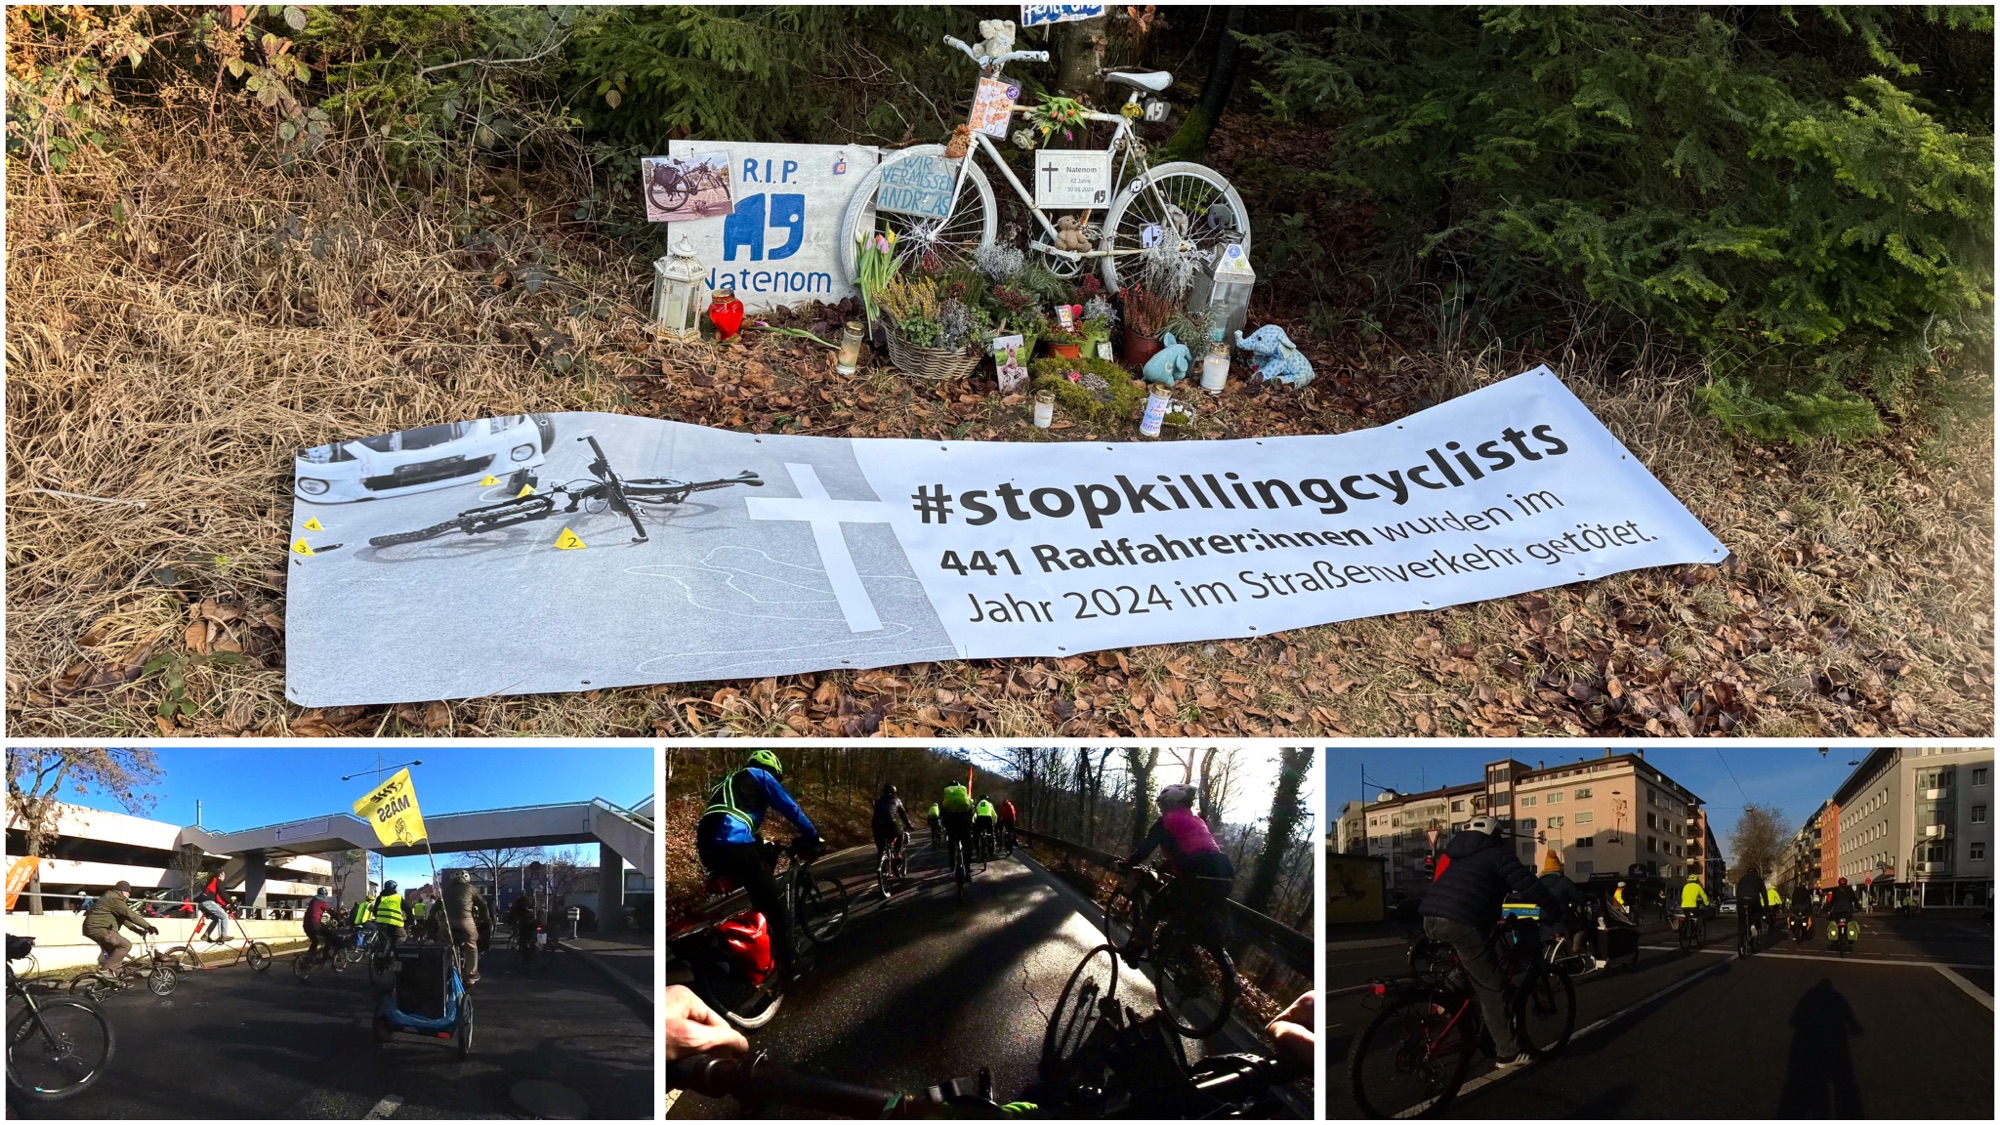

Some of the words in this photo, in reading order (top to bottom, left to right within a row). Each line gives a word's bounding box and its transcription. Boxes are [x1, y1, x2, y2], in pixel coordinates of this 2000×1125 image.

[743, 157, 798, 184] R.I.P.
[904, 156, 933, 171] WIR
[882, 166, 953, 192] VERMISSEN
[878, 186, 952, 217] ANDREAS
[911, 424, 1569, 529] #stopkillingcyclists
[567, 537, 578, 548] 2
[940, 550, 1022, 576] 441
[1030, 528, 1374, 573] Radfahrer:innen
[1372, 510, 1514, 543] wurden
[1506, 490, 1565, 516] im
[967, 593, 1054, 623] Jahr
[1062, 584, 1173, 619] 2024
[1174, 580, 1238, 608] im
[1238, 543, 1523, 600] Straßenverkehr
[1526, 519, 1658, 565] getötet.
